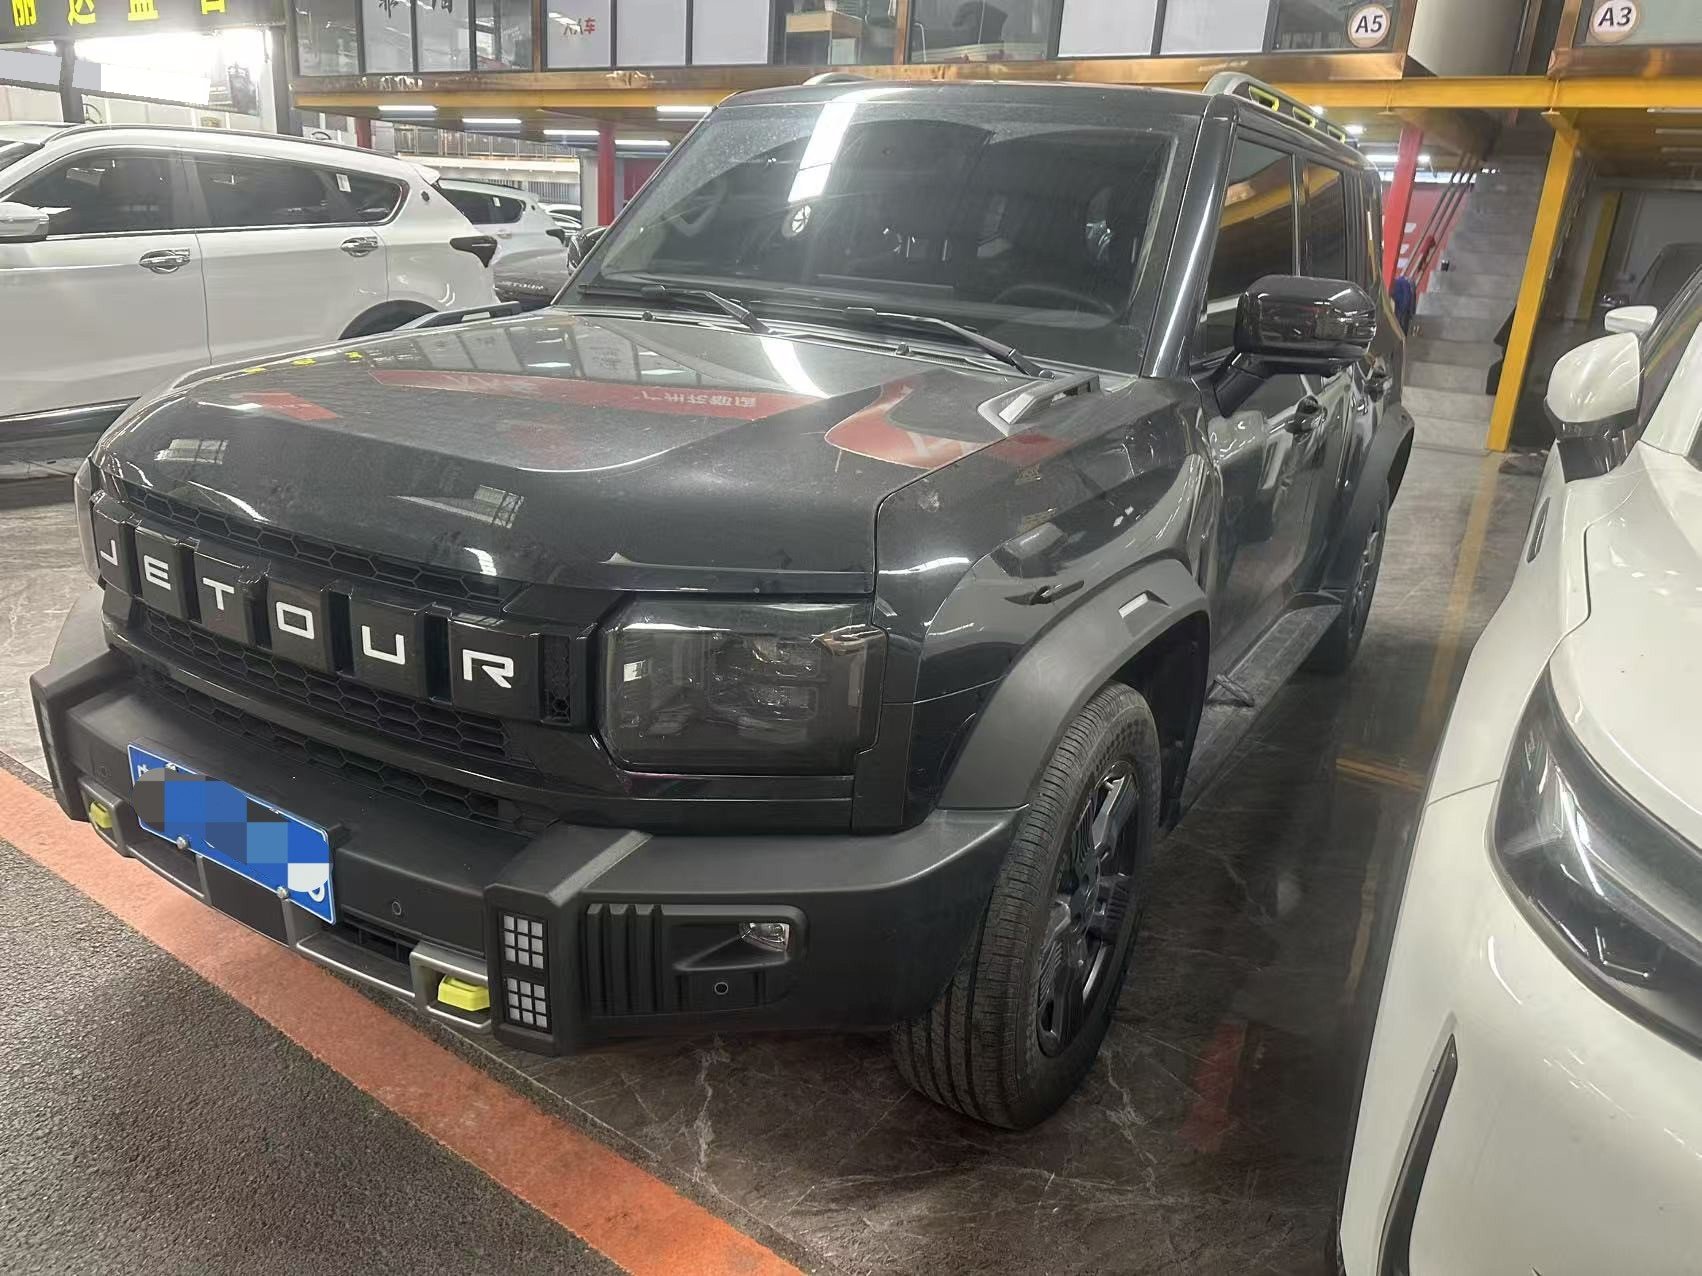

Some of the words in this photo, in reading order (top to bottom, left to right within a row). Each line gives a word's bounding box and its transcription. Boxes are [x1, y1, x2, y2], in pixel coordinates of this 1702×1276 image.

[1355, 15, 1383, 33] A5
[1598, 7, 1632, 26] A3
[100, 540, 515, 689] JETOUR
